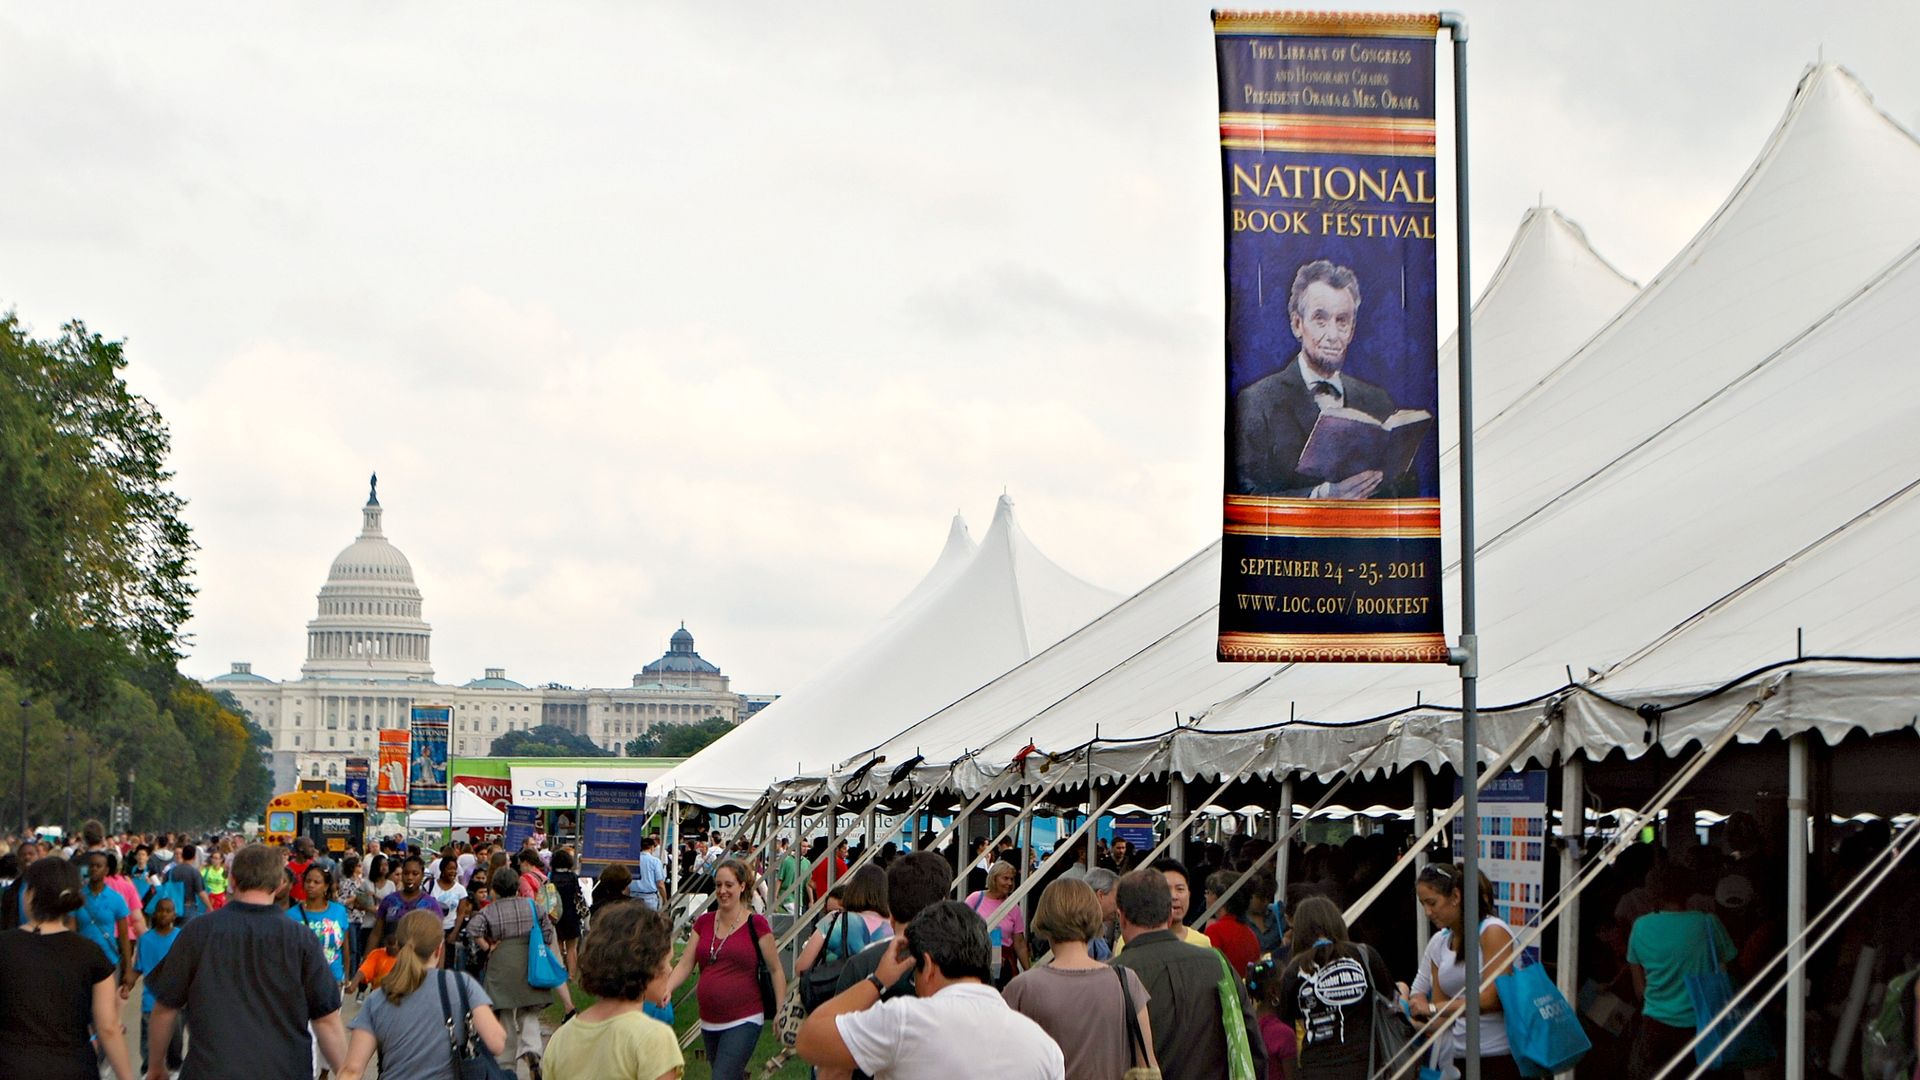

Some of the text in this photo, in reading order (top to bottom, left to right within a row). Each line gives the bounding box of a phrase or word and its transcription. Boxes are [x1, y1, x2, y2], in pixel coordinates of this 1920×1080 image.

[1249, 40, 1412, 65] THE LIBRARY OF CONGRESS
[1275, 68, 1389, 86] AND HONORARY CHAIRS
[1244, 84, 1299, 105] PRESIDENT
[1302, 86, 1340, 107] OBAMA
[1353, 88, 1378, 109] MRS.
[1381, 89, 1421, 111] OBAMA
[1232, 163, 1435, 204] NATIONAL
[1233, 209, 1435, 239] BOOK FESTIVAL
[1240, 558, 1320, 578] SEPTEMBER
[1324, 562, 1343, 585] 24
[1388, 562, 1425, 579] 2011
[1237, 591, 1429, 615] WWW.LOC.GOV/BOOKFEST
